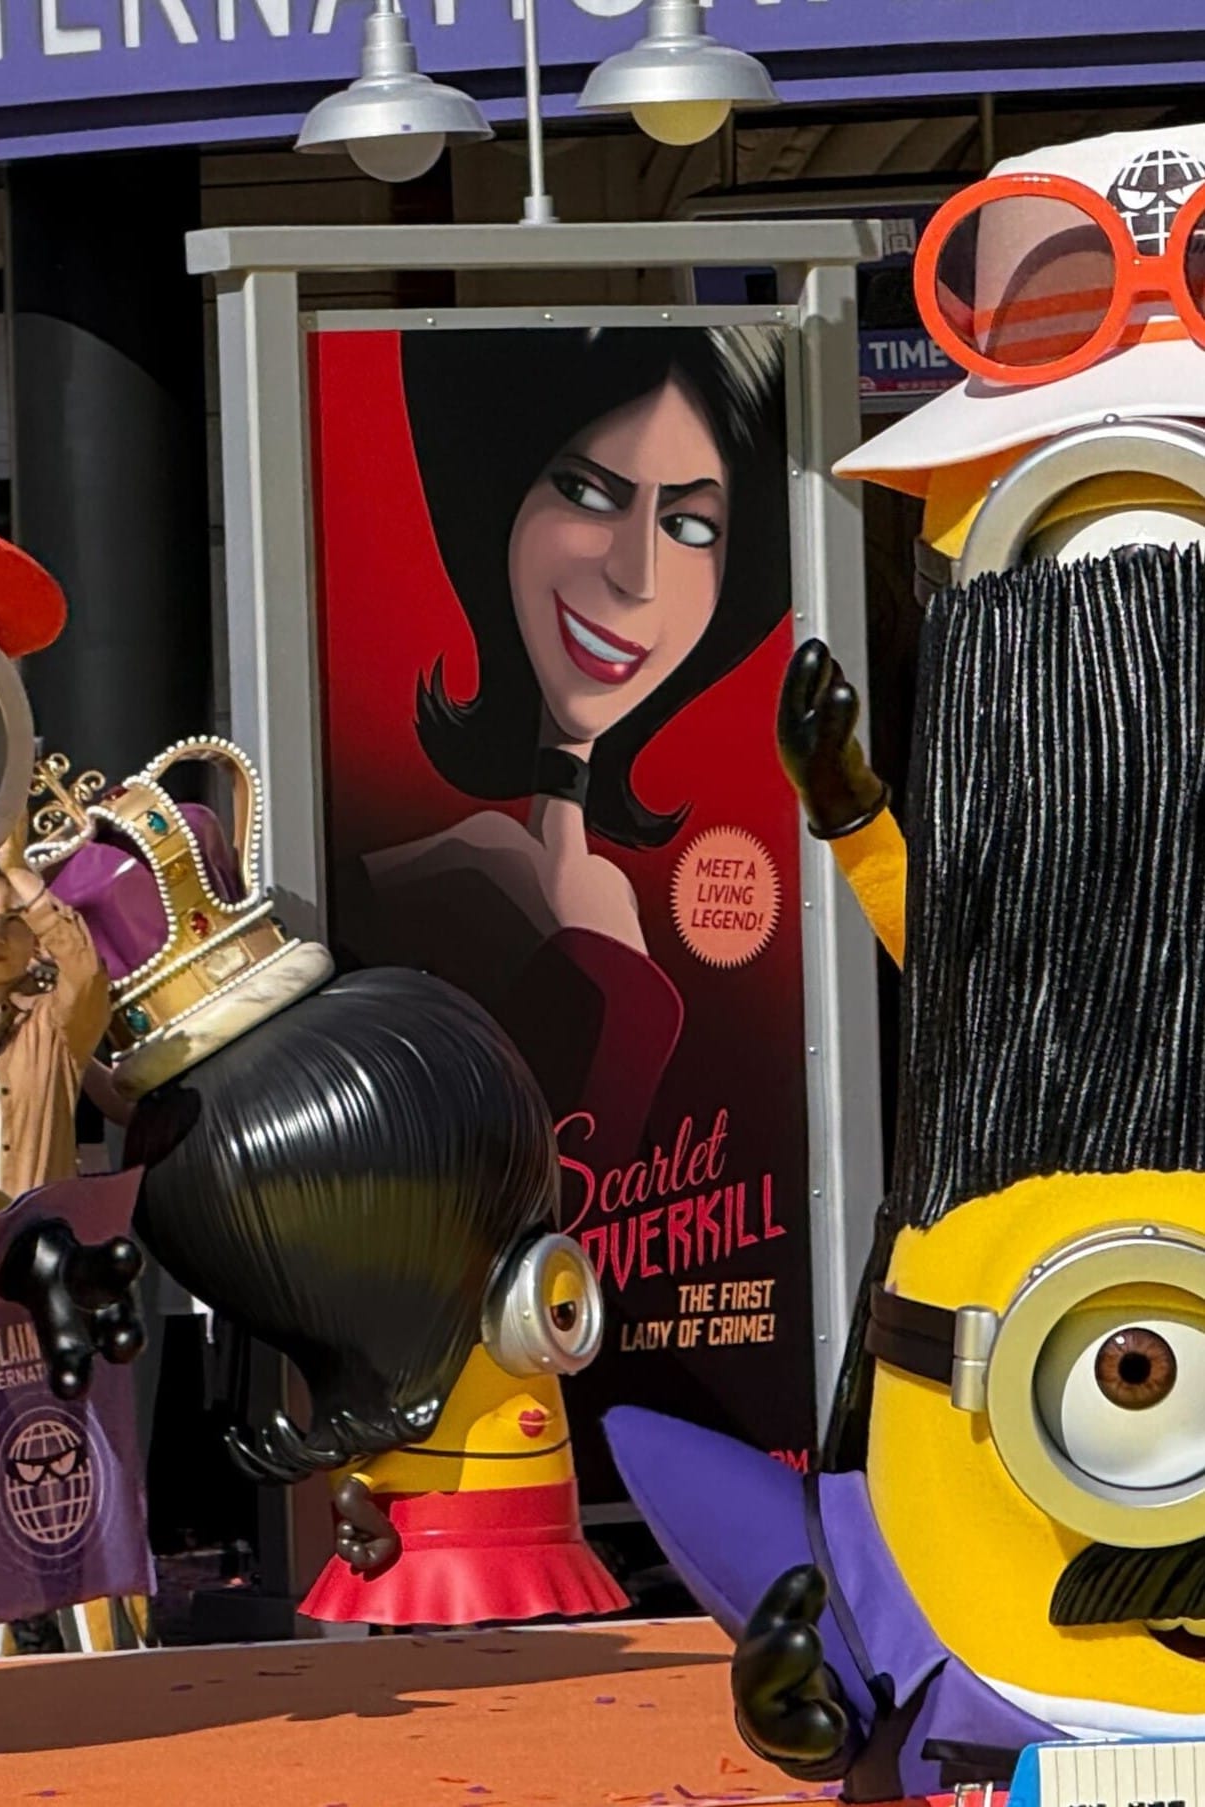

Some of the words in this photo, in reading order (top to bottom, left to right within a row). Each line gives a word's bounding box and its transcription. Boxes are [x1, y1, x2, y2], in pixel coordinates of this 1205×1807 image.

[868, 341, 948, 371] TIME
[695, 858, 743, 880] MEET
[745, 861, 756, 880] A
[697, 883, 754, 905] LIVING
[691, 908, 764, 931] LEGEND!
[554, 1108, 728, 1235] Scarlet
[580, 1174, 787, 1292] OVERKILL
[678, 1283, 715, 1314] THE
[720, 1279, 776, 1310] FIRST
[620, 1320, 674, 1352] LADY
[678, 1319, 704, 1348] OF
[709, 1314, 776, 1346] CRIME!
